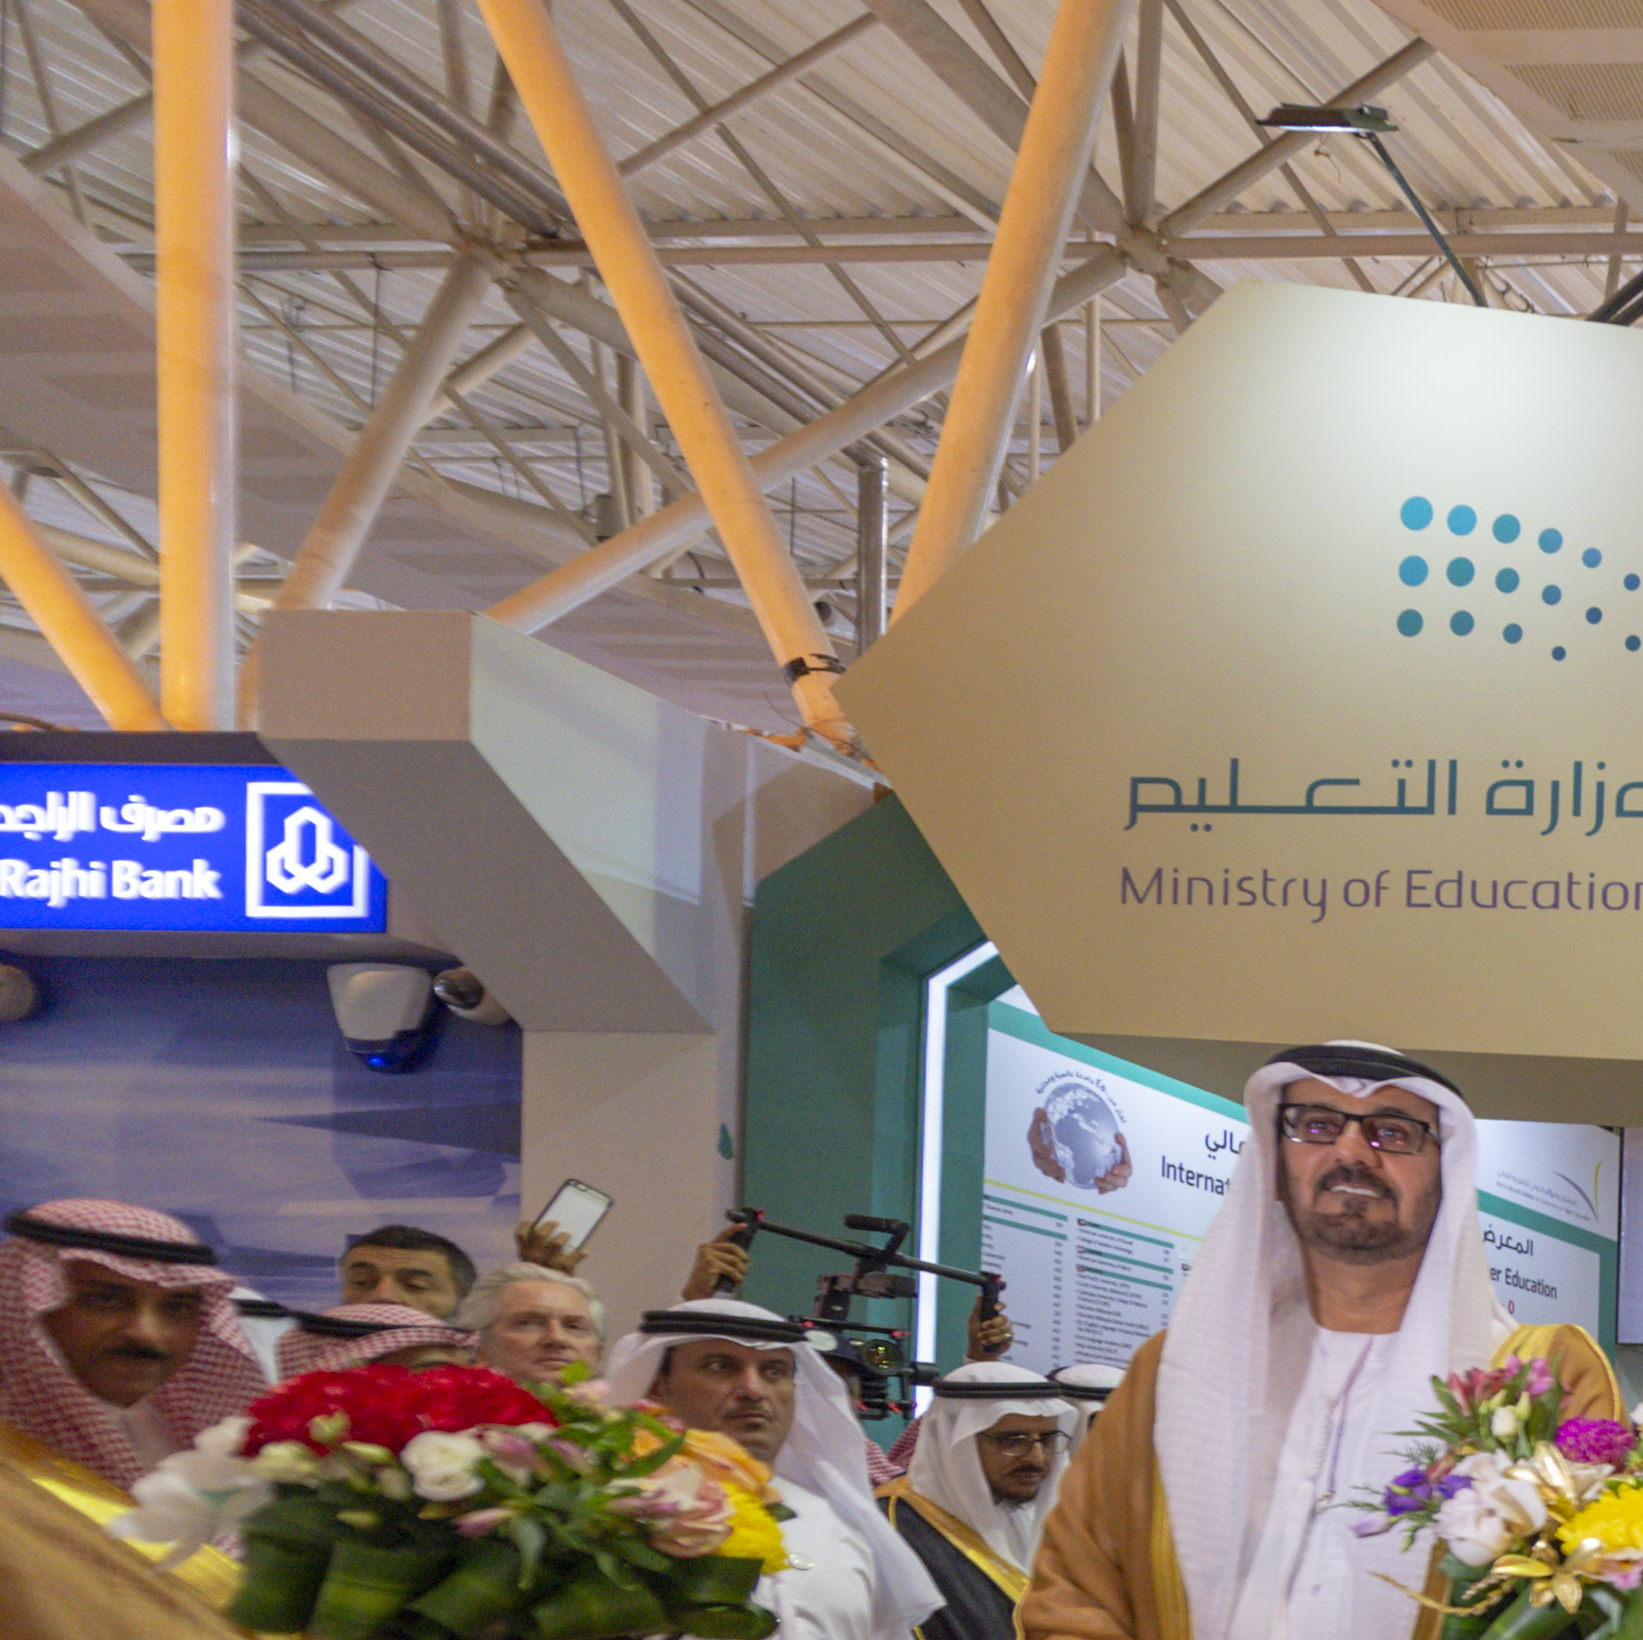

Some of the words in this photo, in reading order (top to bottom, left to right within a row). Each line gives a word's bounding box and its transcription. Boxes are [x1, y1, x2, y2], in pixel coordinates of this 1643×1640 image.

[0, 790, 97, 842] الراجح
[100, 794, 226, 842] مصرف
[1123, 757, 1459, 832] التعليم
[0, 857, 107, 908] Rajhi
[112, 858, 224, 899] Bank
[1120, 865, 1328, 924] Ministry
[1342, 868, 1391, 908] of
[1161, 1155, 1229, 1196] Interna
[1505, 1267, 1558, 1300] Education
